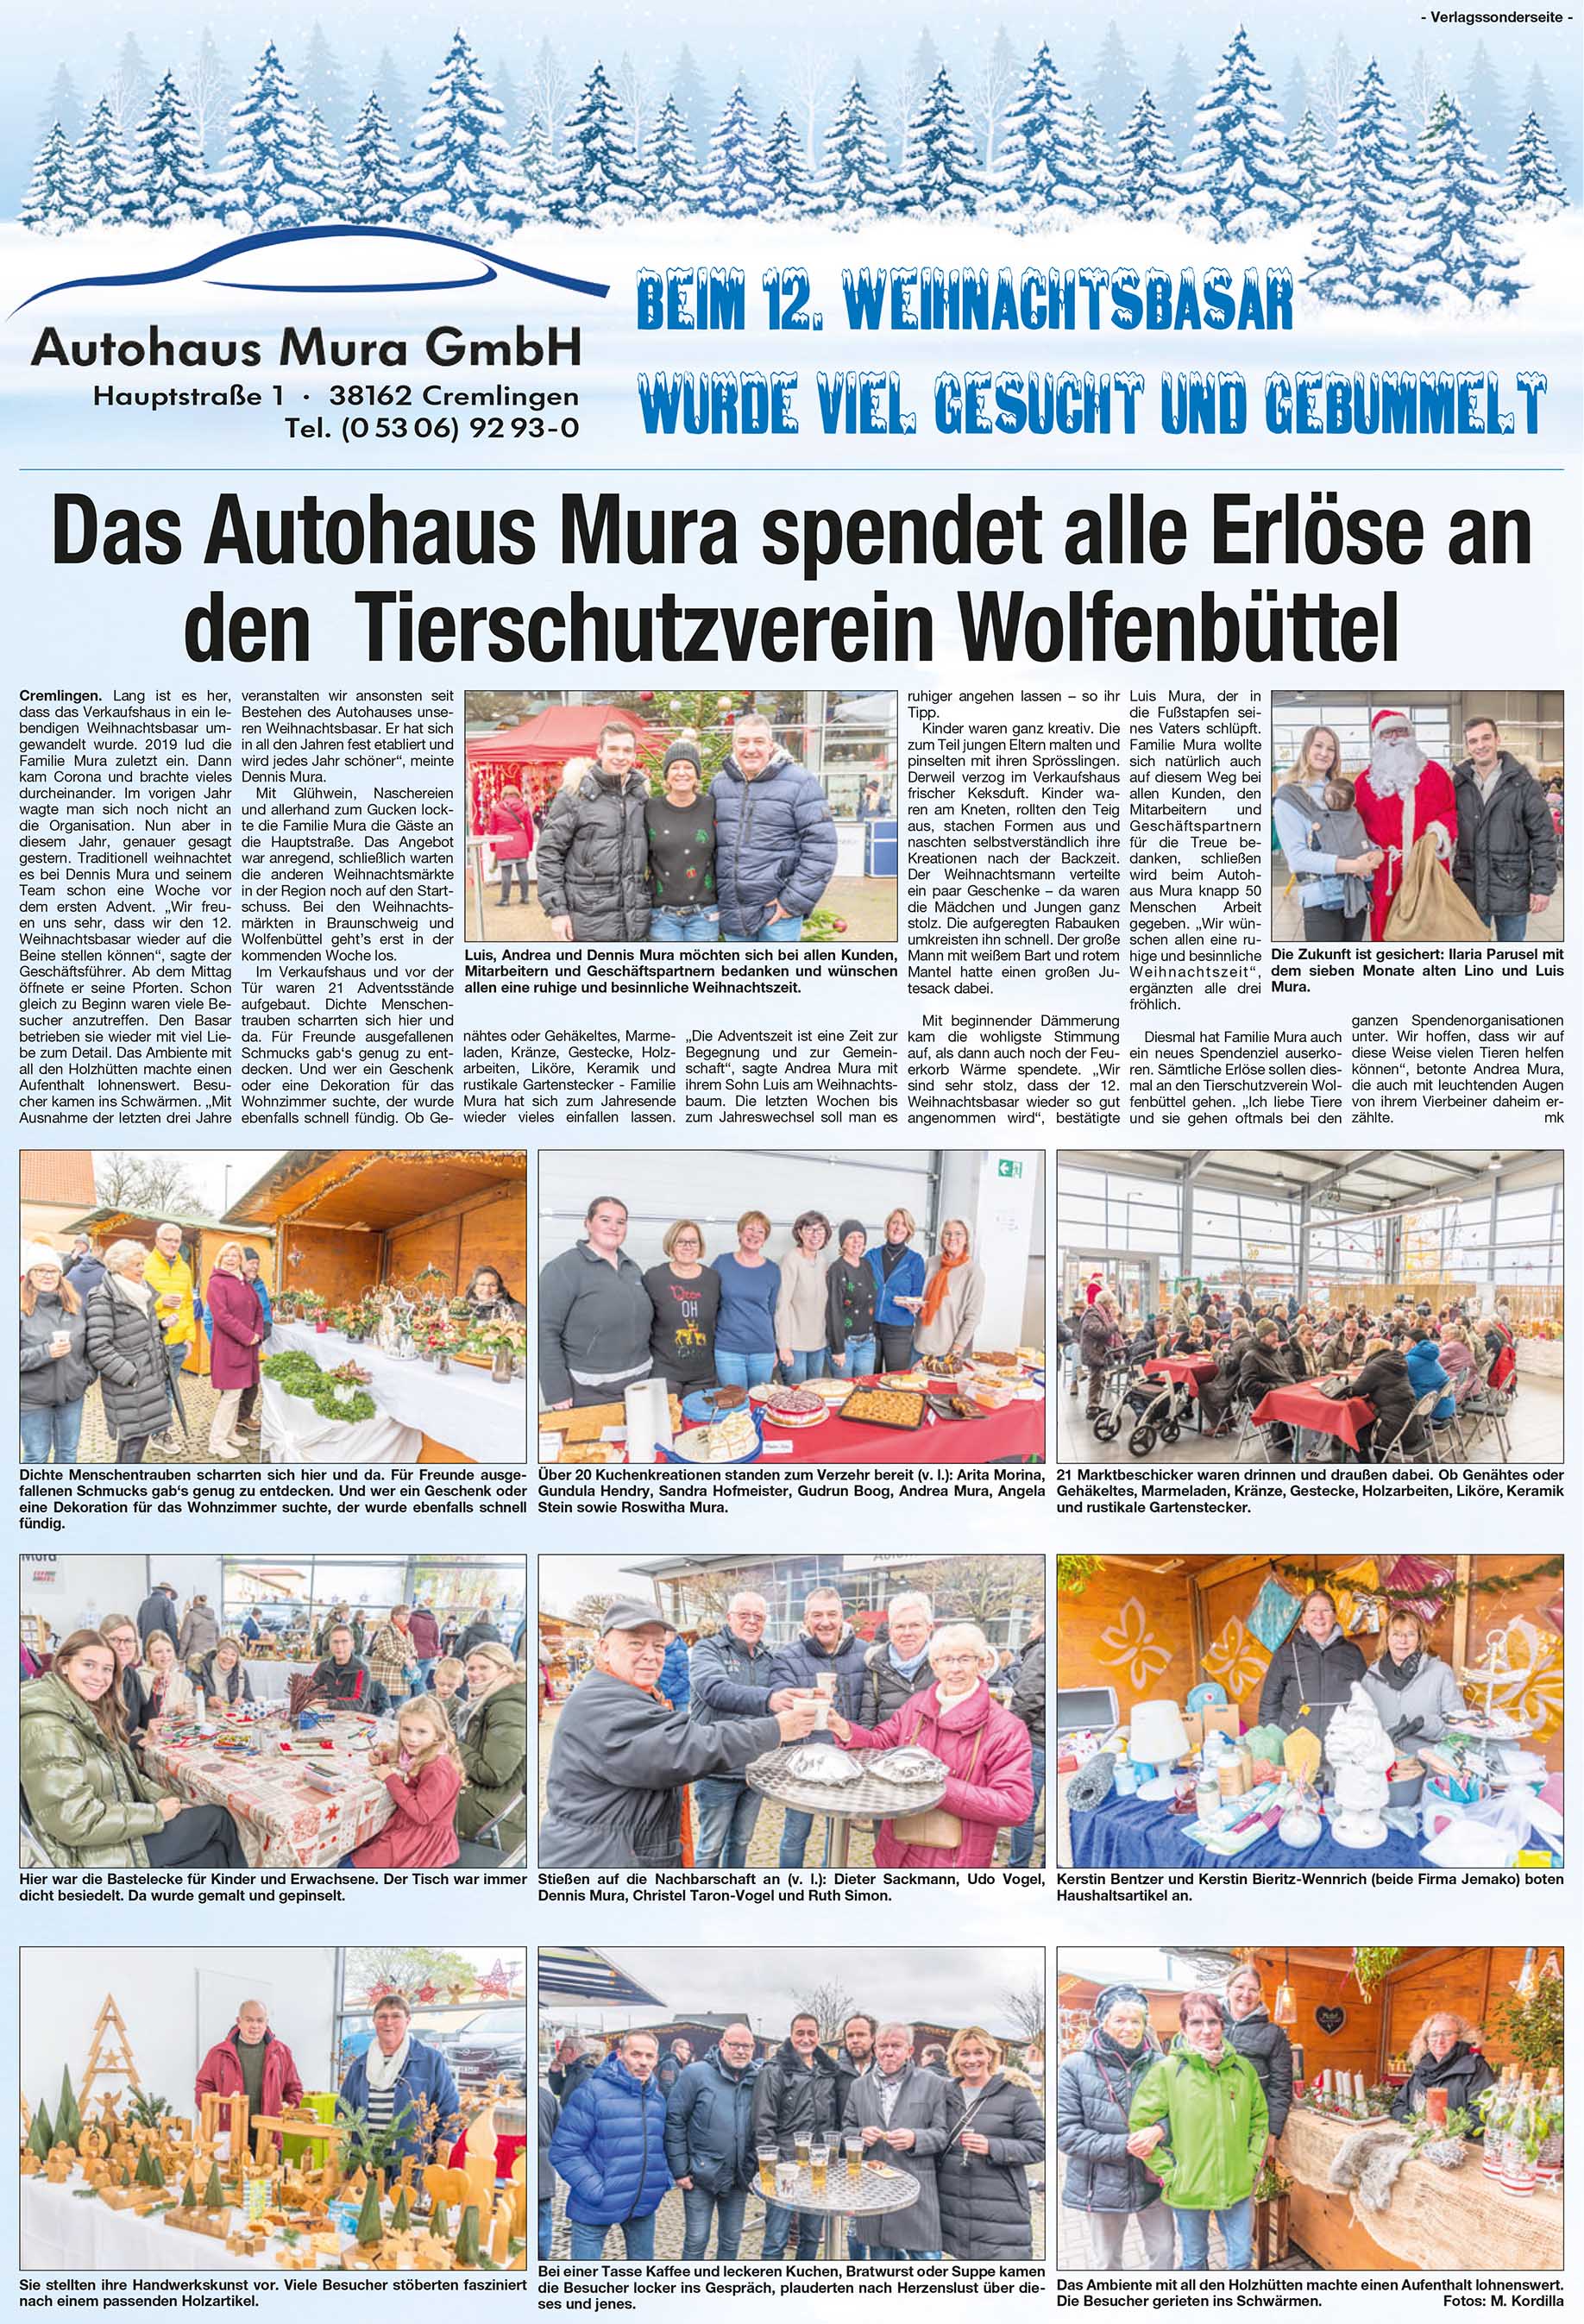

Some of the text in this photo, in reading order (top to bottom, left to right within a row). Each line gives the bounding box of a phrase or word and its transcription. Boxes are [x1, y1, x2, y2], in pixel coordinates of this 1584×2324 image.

[1430, 10, 1563, 26] Verlagssonderseite
[636, 266, 1294, 332] BEIM 12. WEIHNACHTSBASAR
[30, 324, 581, 367] Autohaus Mura GmbH
[94, 383, 579, 411] Hauptstraße 1 38162 Cremlingen
[636, 369, 1549, 437] WURDE VIEL GESUCHT UND GEBUMMELT
[284, 416, 331, 438] Tel.
[53, 491, 1531, 581] Das Autohaus Mura spendet alle Erlöse an
[185, 588, 1398, 663] den Tierschutzverein Wolfenbüttel
[19, 689, 231, 705] Cremlingen. Lang ist es her,
[242, 706, 454, 718] Bestehen des Autohauses unse-
[908, 754, 1120, 769] pinselten mit ihren Sprösslingen.
[1129, 820, 1261, 835] Geschäftspartnern
[464, 948, 898, 964] Luis, Andrea und Dennis Mura möchten sich bei allen Kunden,
[1271, 947, 1565, 964] Die Zukunft ist gesichert: Ilaria Parusel mit
[1271, 964, 1565, 977] dem sieben Monate alten Lino und Luis
[1271, 980, 1311, 993] Mura.
[1351, 1014, 1564, 1029] ganzen Spendenorganisationen
[463, 1029, 676, 1044] nähtes oder Gehäkeltes, Marme-
[685, 1029, 898, 1044] „Die Adventszeit ist eine Zeit zur
[1351, 1111, 1565, 1123] zählte. mk
[682, 1300, 698, 1318] OH
[19, 1468, 527, 1484] Dichte Menschentrauben scharrten sich hier und da. Für Freunde ausge-
[1056, 1468, 1565, 1481] 21 Marktbeschicker waren drinnen und draußen dabei. Ob Genähtes oder
[537, 1500, 728, 1513] Stein sowie Roswitha Mura.
[1057, 1872, 1564, 1888] Kerstin Bentzer und Kerstin Bieritz-Wennrich (beide Firma Jemako) boten
[19, 1888, 346, 1905] dicht besiedelt. Da wurde gemalt und gepinselt.
[537, 1888, 892, 1905] Dennis Mura, Christel Taron-Vogel und Ruth Simon.
[1057, 1889, 1192, 1901] Haushaltsartikel an.
[19, 2294, 259, 2310] nach einem passenden Holzartikel.
[537, 2297, 636, 2313] ses und jenes.
[1057, 2294, 1323, 2310] Die Besucher gerieten ins Schwärmen.
[1443, 2295, 1564, 2307] Fotos: M. Kordilla
